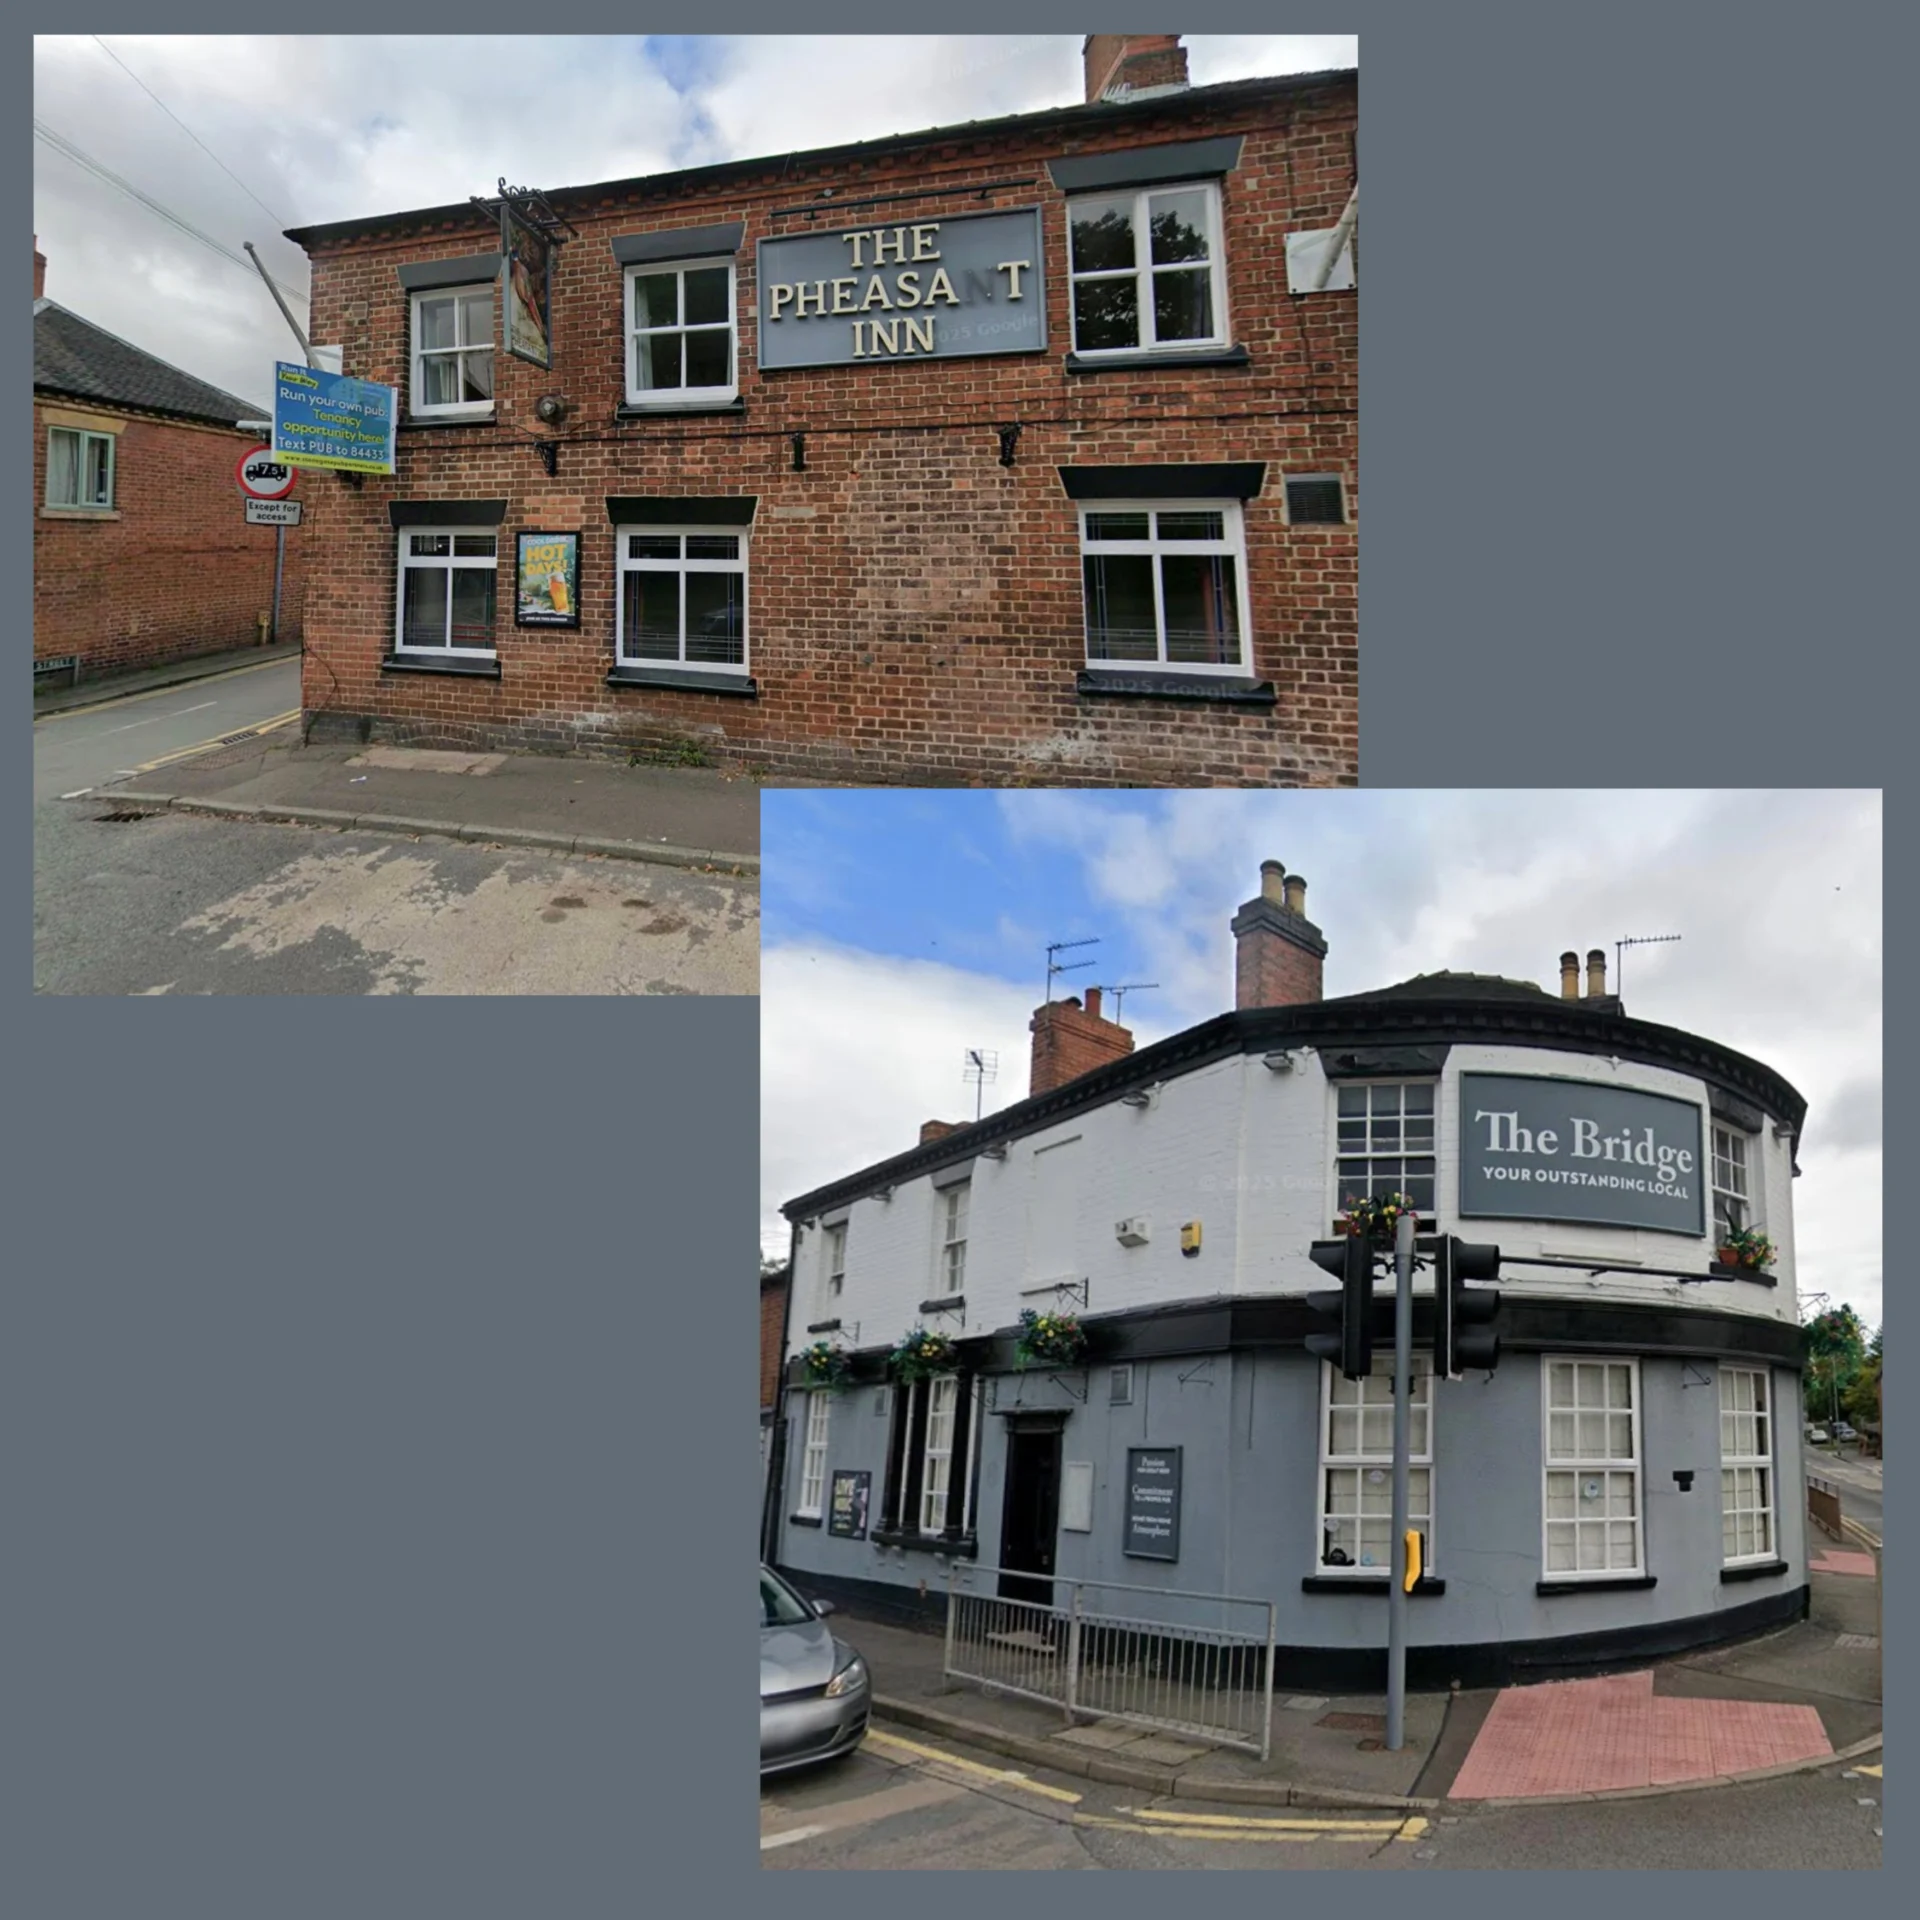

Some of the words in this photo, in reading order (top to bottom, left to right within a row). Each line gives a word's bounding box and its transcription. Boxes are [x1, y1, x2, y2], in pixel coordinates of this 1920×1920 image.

[843, 223, 941, 268] THE
[852, 315, 936, 358] INN
[280, 363, 299, 374] Run
[280, 387, 306, 402] Run
[308, 395, 336, 407] your
[338, 401, 362, 413] own
[313, 408, 362, 429] Tenancy
[282, 421, 357, 442] opportunity
[278, 436, 306, 450] Text
[309, 441, 333, 453] PUB
[336, 445, 349, 456] to
[350, 446, 385, 460] 84433
[248, 501, 280, 512] Except
[282, 504, 297, 513] for
[256, 512, 287, 521] access
[526, 544, 568, 562] HOT
[525, 559, 568, 576] DAYS!
[1475, 1109, 1559, 1155] The
[1570, 1117, 1694, 1182] Bridge
[1483, 1166, 1531, 1181] YOUR
[1535, 1169, 1645, 1192] OUTSTANDING
[1648, 1181, 1689, 1199] LOCAL
